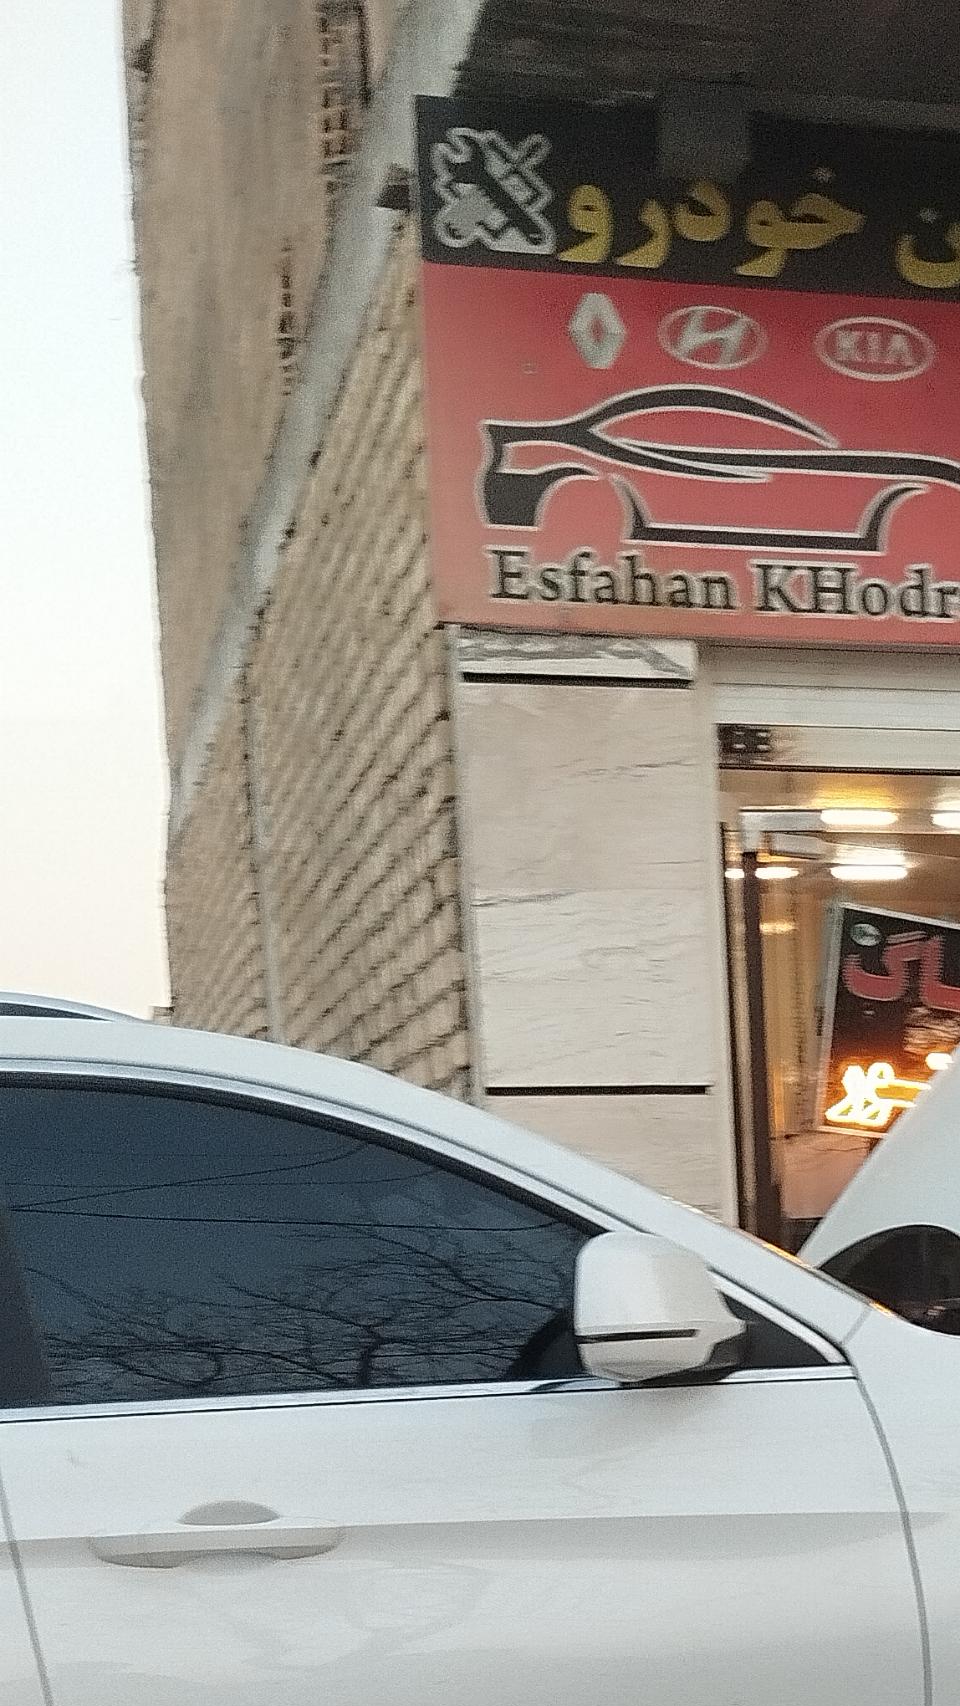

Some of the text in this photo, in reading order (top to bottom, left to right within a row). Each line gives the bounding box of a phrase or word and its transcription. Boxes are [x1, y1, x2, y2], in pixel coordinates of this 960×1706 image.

[558, 166, 866, 279] خودرو
[836, 329, 918, 367] KIA
[488, 546, 740, 613] Esfahan
